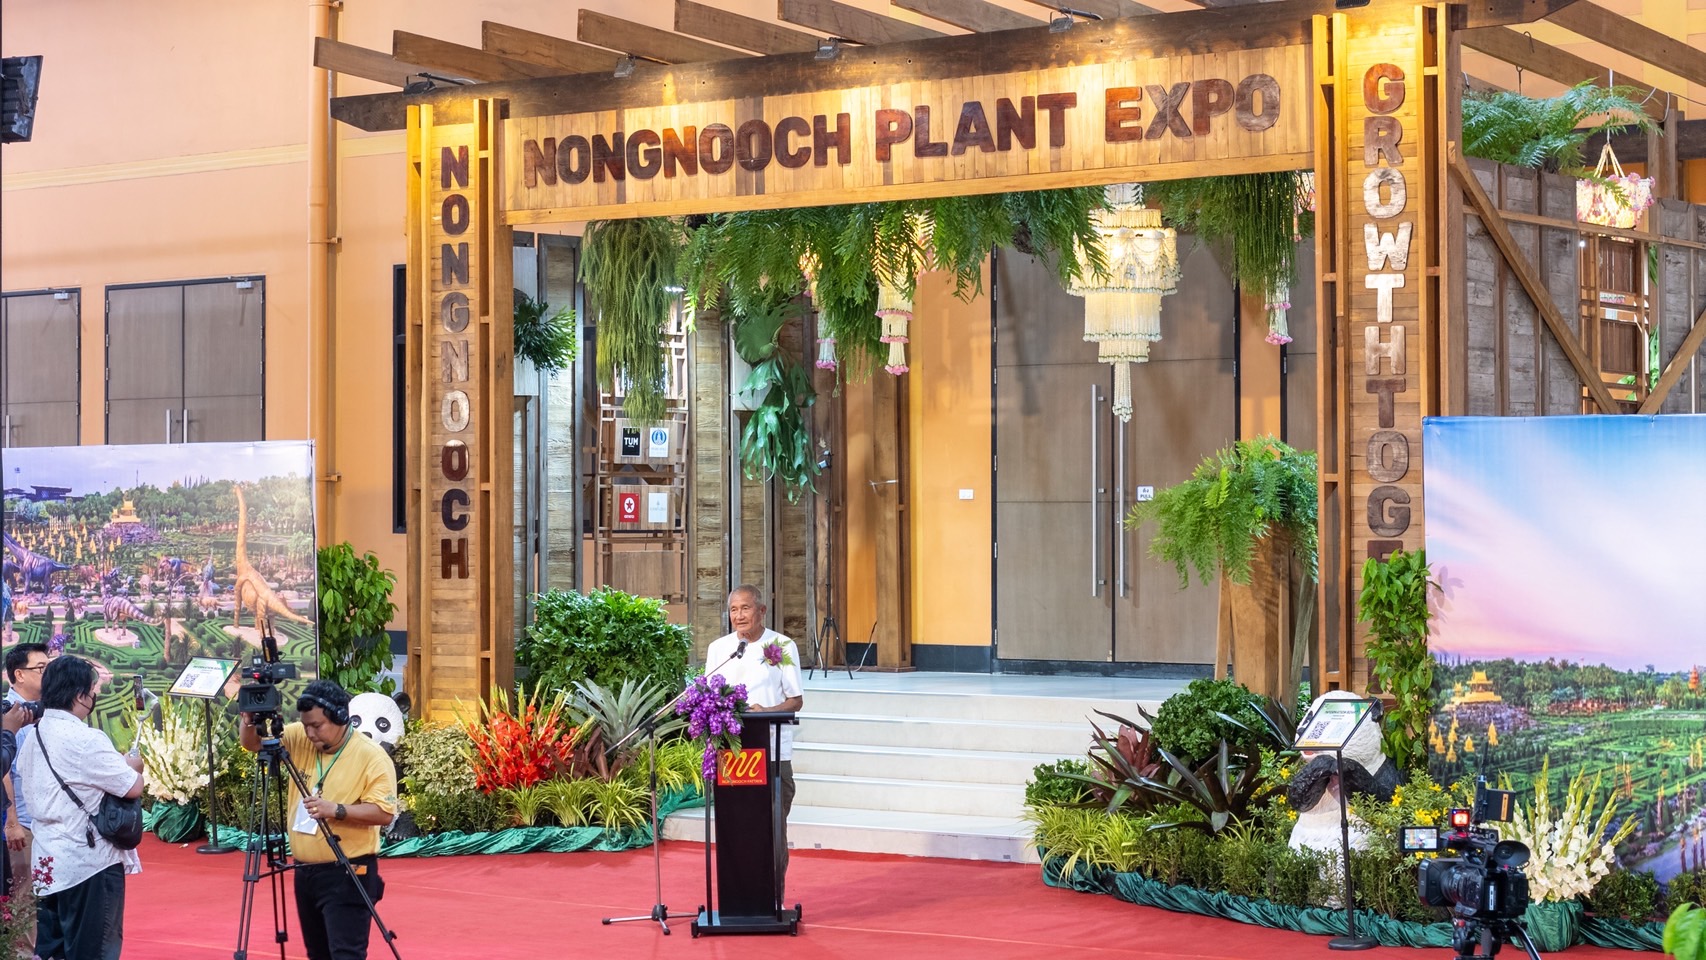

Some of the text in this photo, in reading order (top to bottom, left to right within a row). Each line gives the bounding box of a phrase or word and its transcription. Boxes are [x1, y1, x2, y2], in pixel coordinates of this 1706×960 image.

[523, 73, 1281, 189] NONGNOOCH PLANT EXPO
[441, 145, 470, 579] NONGNOOCH
